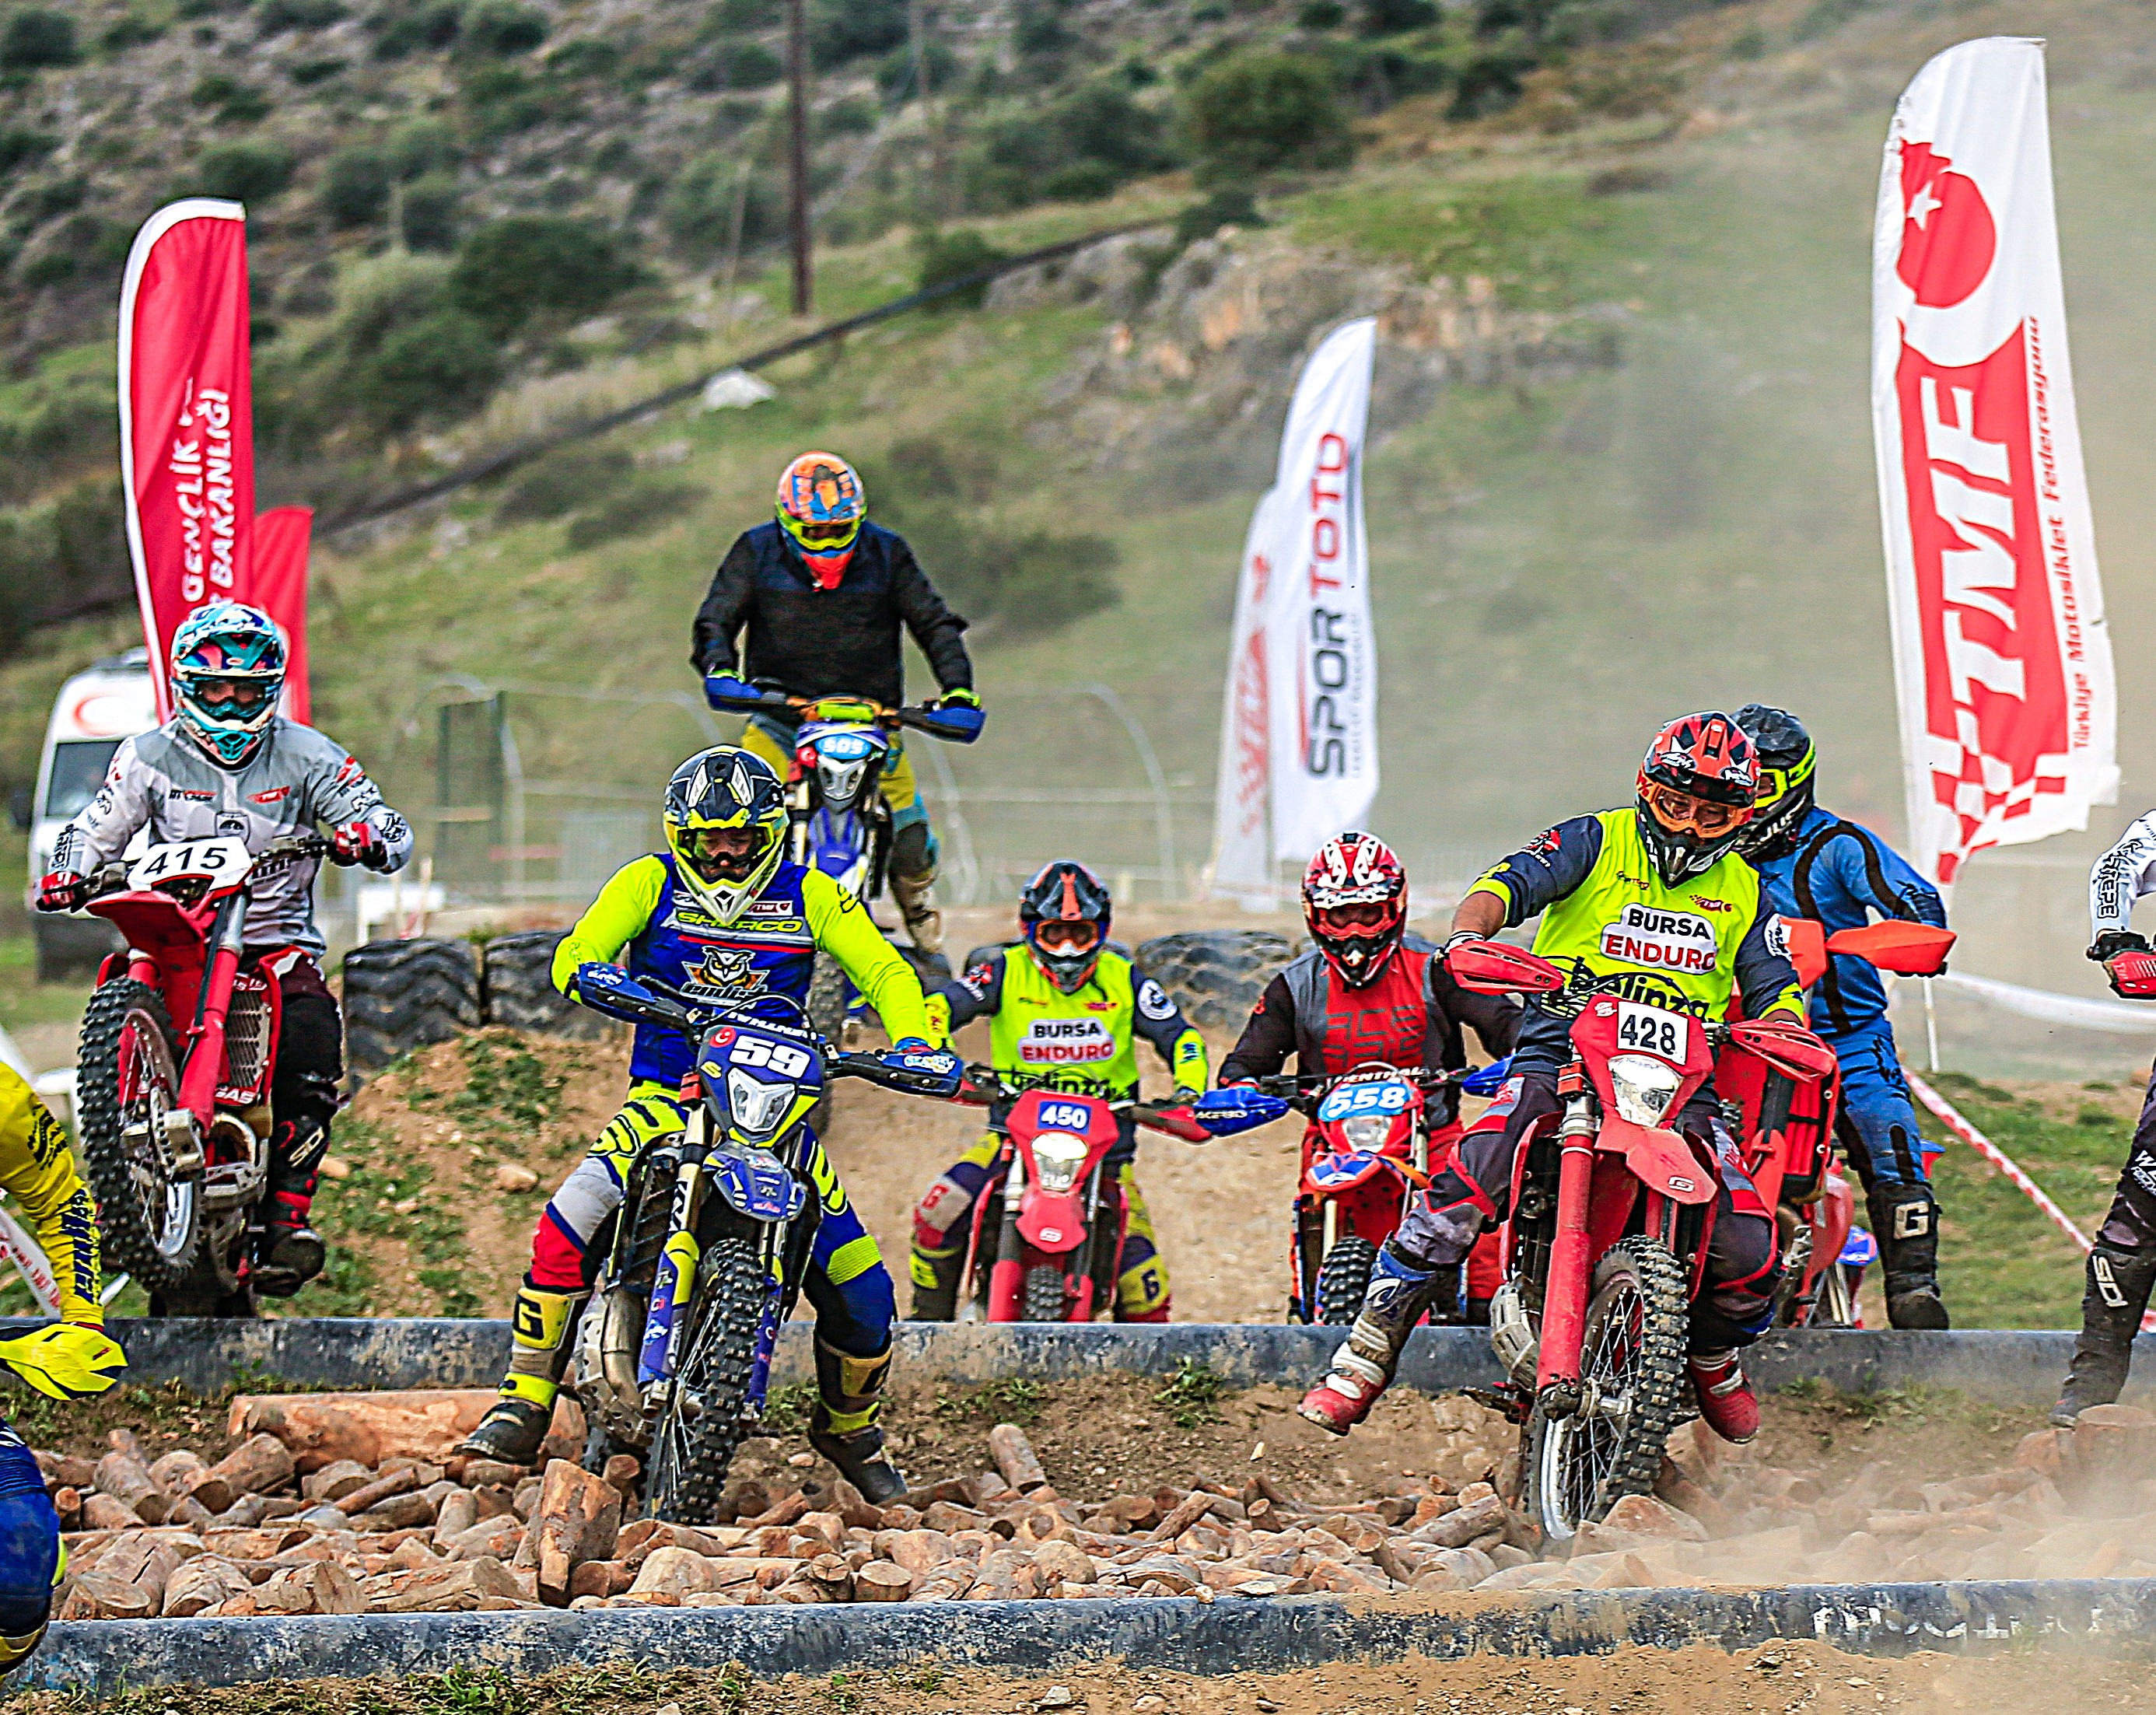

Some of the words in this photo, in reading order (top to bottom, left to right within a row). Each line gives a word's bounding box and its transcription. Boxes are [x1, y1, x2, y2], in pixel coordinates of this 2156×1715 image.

[1920, 376, 2026, 705] TMF
[143, 846, 228, 875] 415
[1628, 908, 1711, 940] BURSA
[1605, 934, 1716, 971] ENDURO
[1034, 1022, 1101, 1038] BURSA
[1620, 1014, 1676, 1055] 428
[729, 1034, 811, 1080] 59
[1021, 1041, 1114, 1061] ENDURO
[1041, 1104, 1087, 1129] 450
[1326, 1087, 1407, 1118] 558
